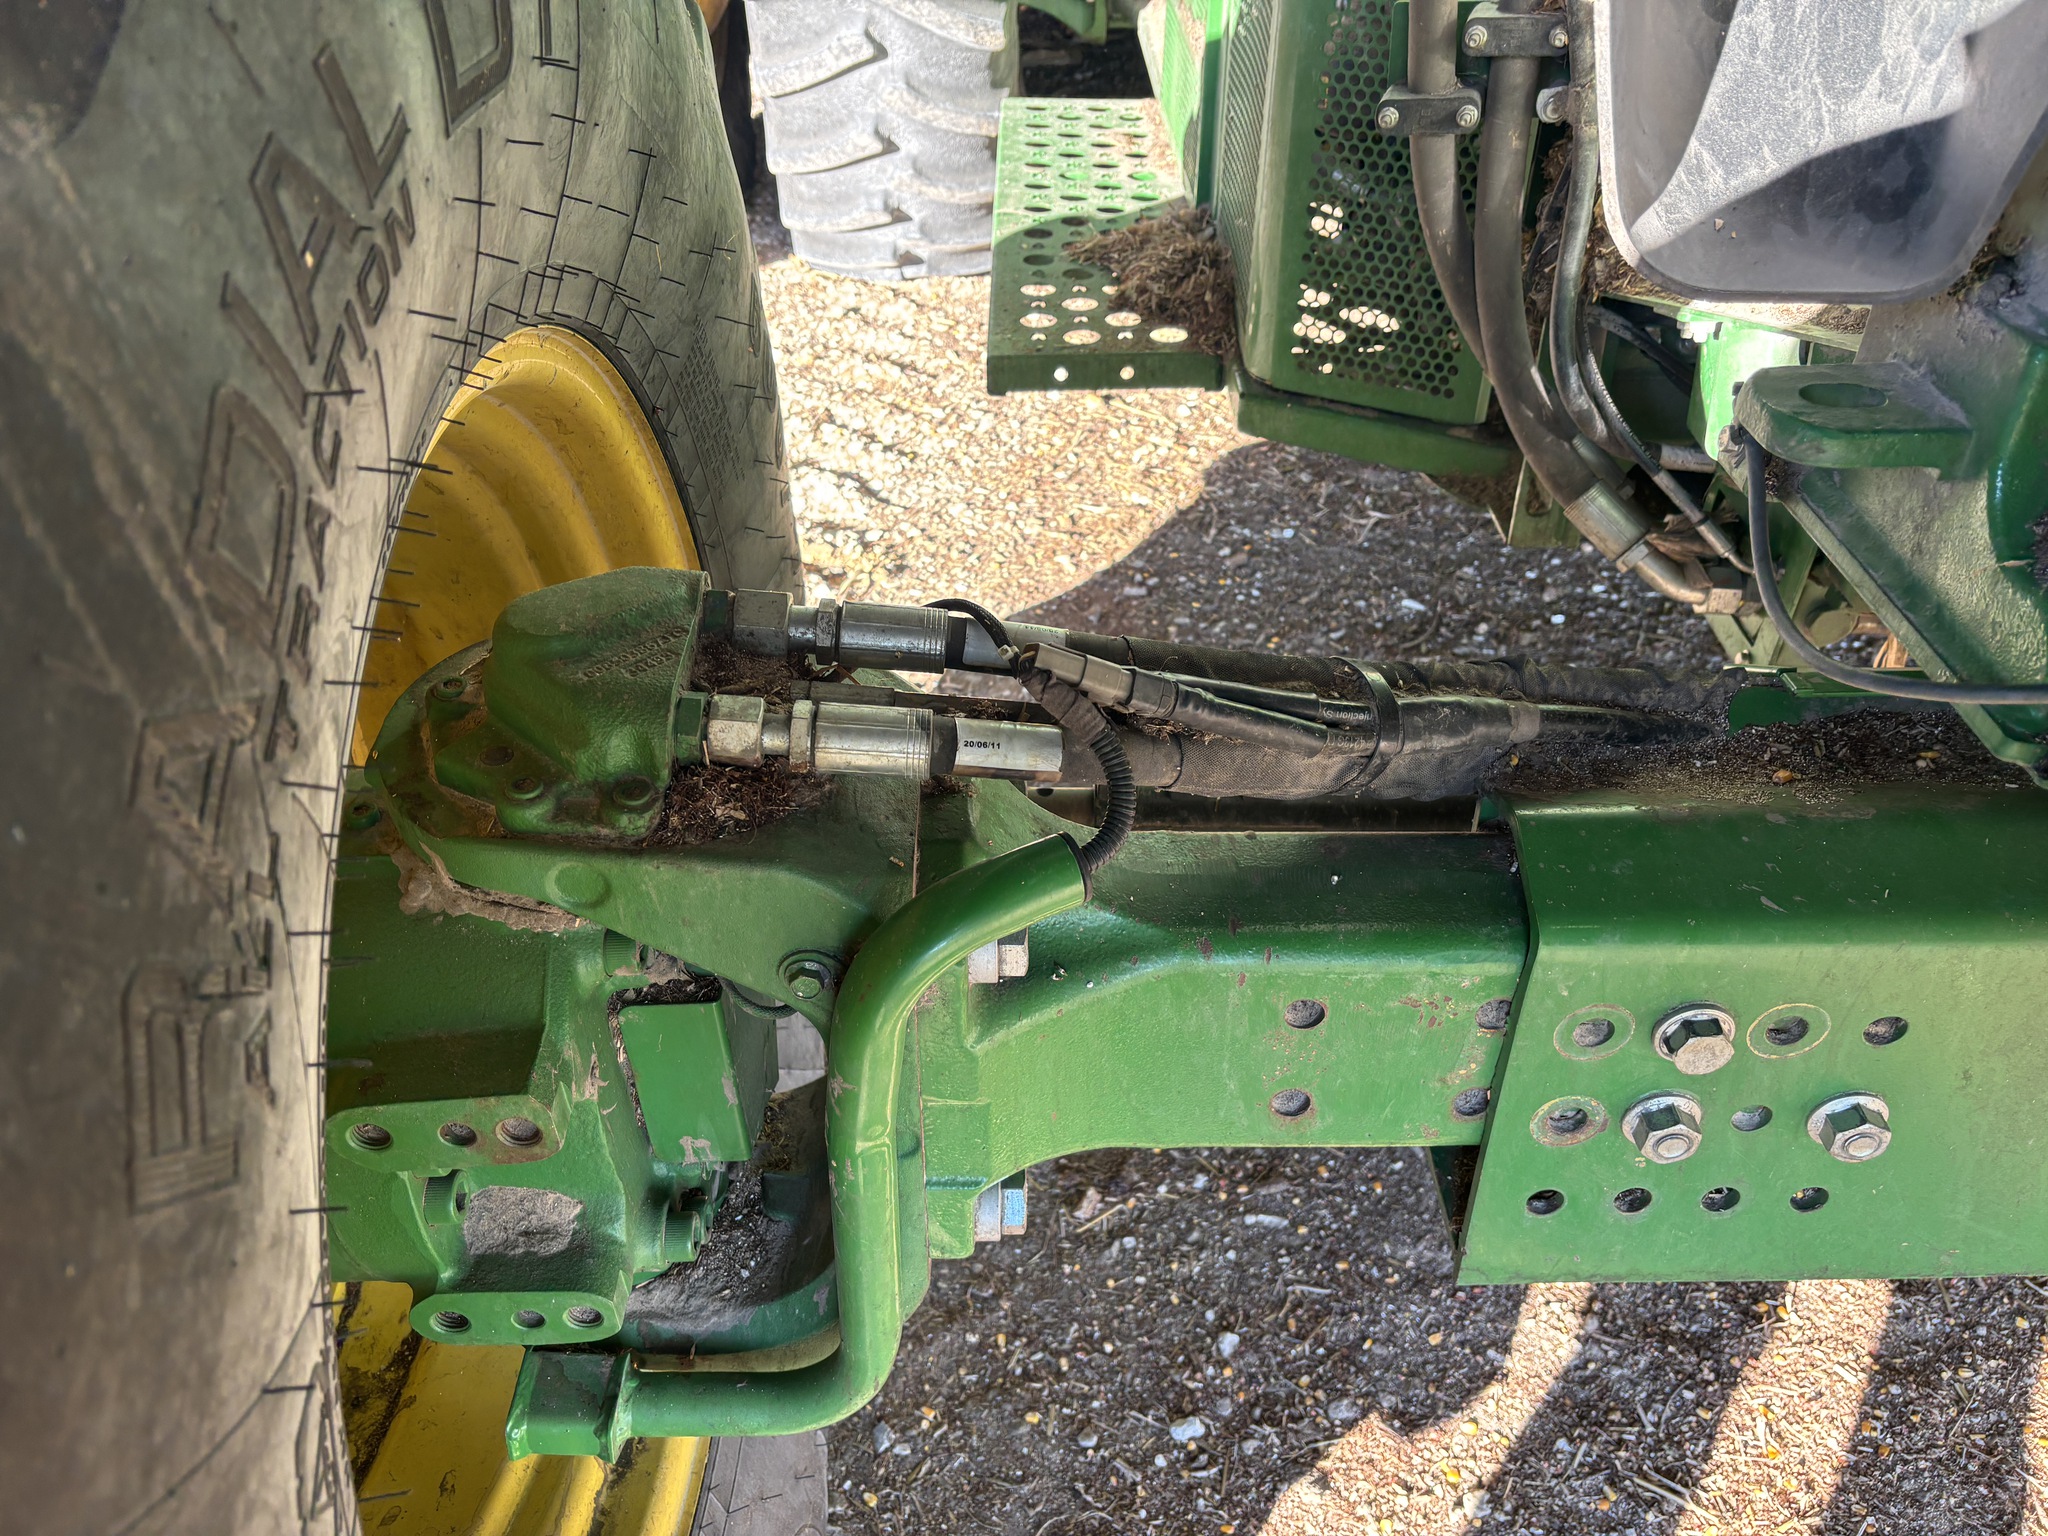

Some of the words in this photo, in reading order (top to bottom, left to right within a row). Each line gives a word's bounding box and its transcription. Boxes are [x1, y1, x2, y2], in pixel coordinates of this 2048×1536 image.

[264, 179, 416, 762] TRACTION
[120, 41, 411, 1215] RADIAL
[1323, 708, 1334, 718] Sy
[1336, 711, 1373, 721] njection
[963, 740, 1001, 750] 20/06/11
